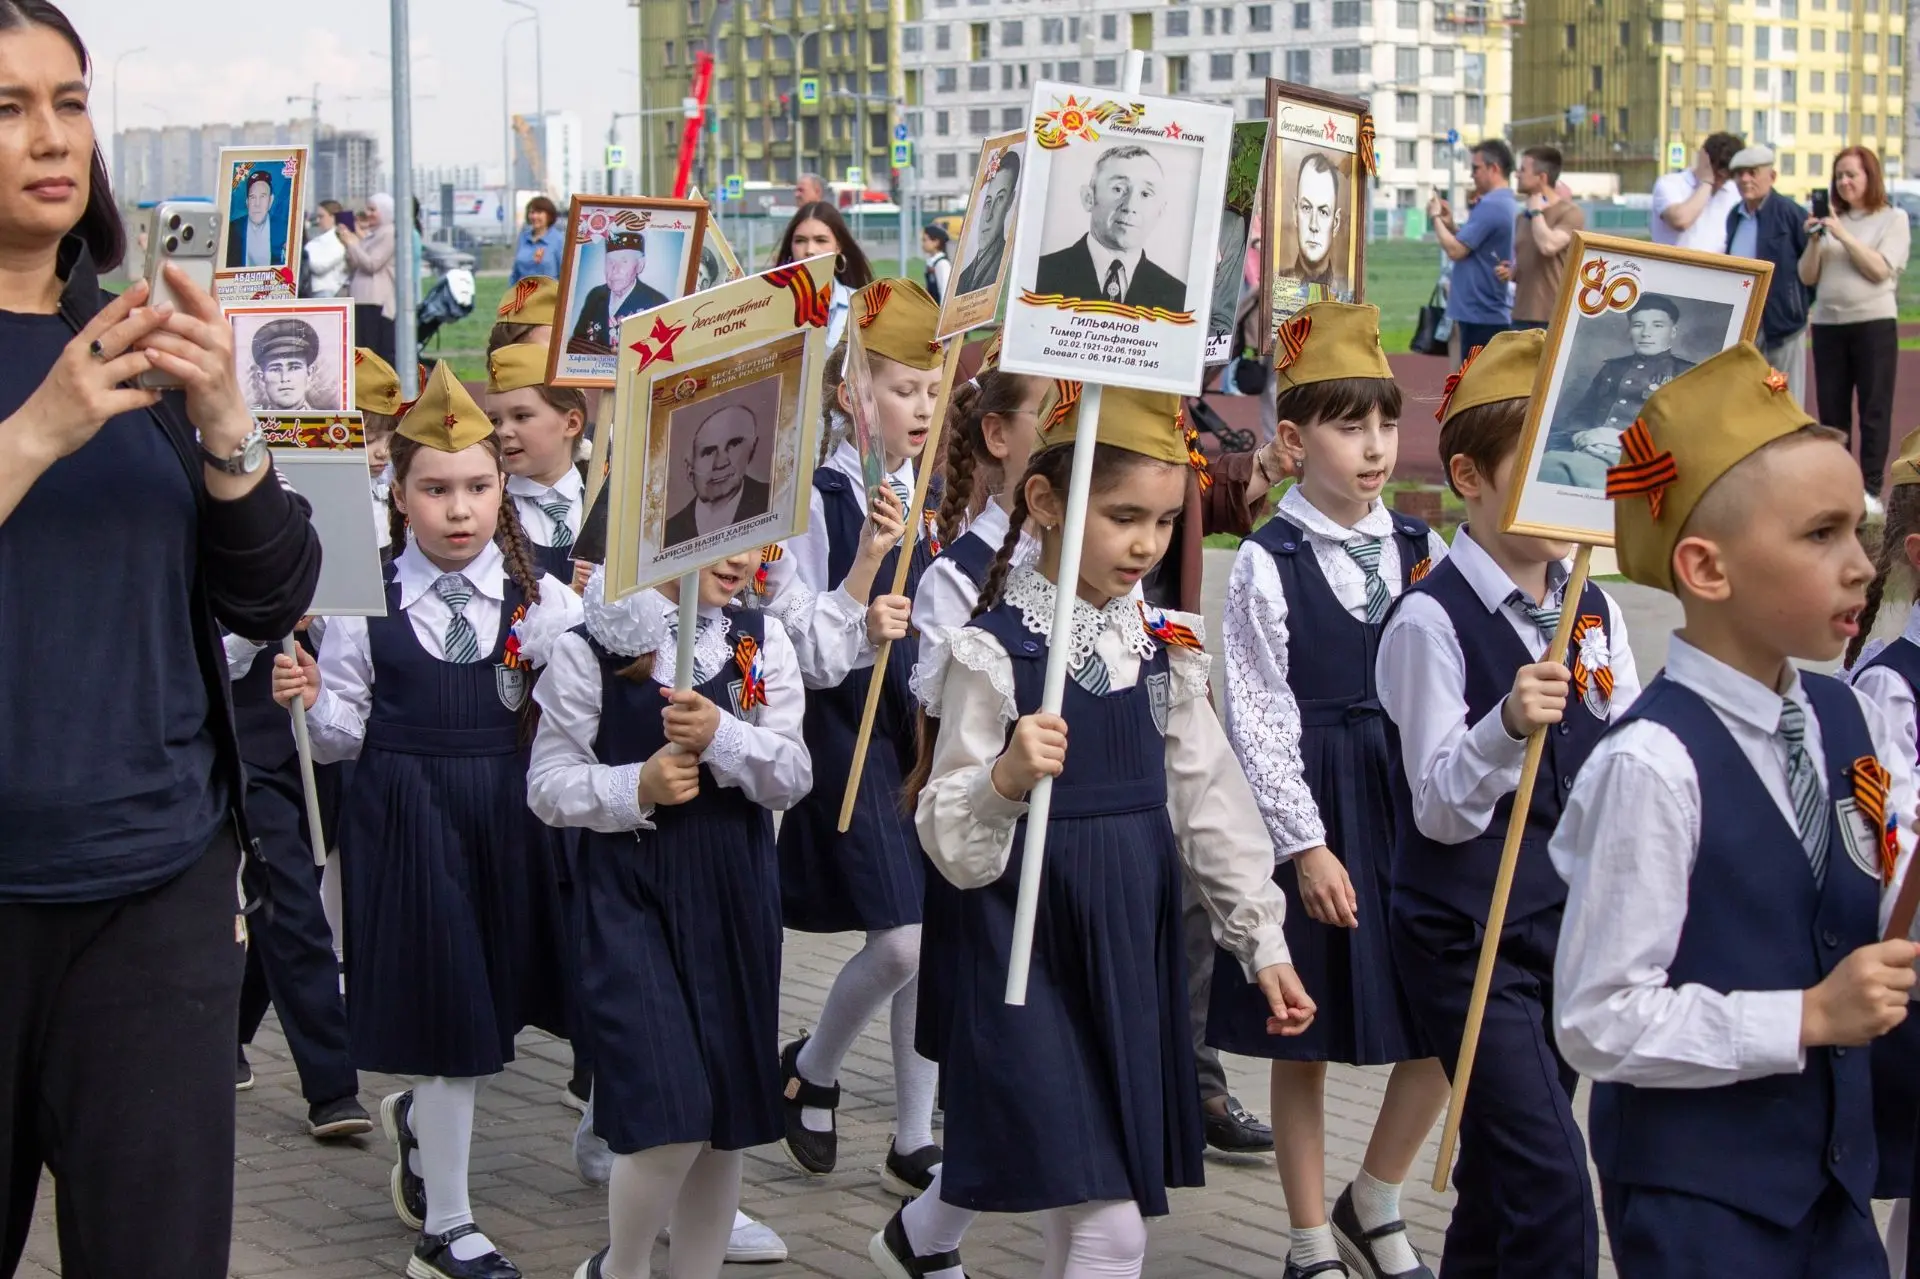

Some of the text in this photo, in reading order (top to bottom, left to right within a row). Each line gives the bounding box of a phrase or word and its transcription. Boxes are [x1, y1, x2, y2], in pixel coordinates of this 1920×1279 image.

[1181, 132, 1205, 143] полк
[1336, 133, 1354, 146] полк
[234, 272, 276, 282] АБДУЛЛИН
[1070, 316, 1140, 334] ГИЛЬФАНОВ
[1050, 326, 1159, 348] Тимер Гильфанович
[1058, 339, 1147, 357] 02.02.1921-02.06.1993
[1043, 347, 1078, 359] Воевал
[1087, 352, 1160, 369] 06.1941-08.1945
[652, 543, 694, 564] ХАРИСОВ
[726, 512, 779, 537] ХАРИСОВИЧ
